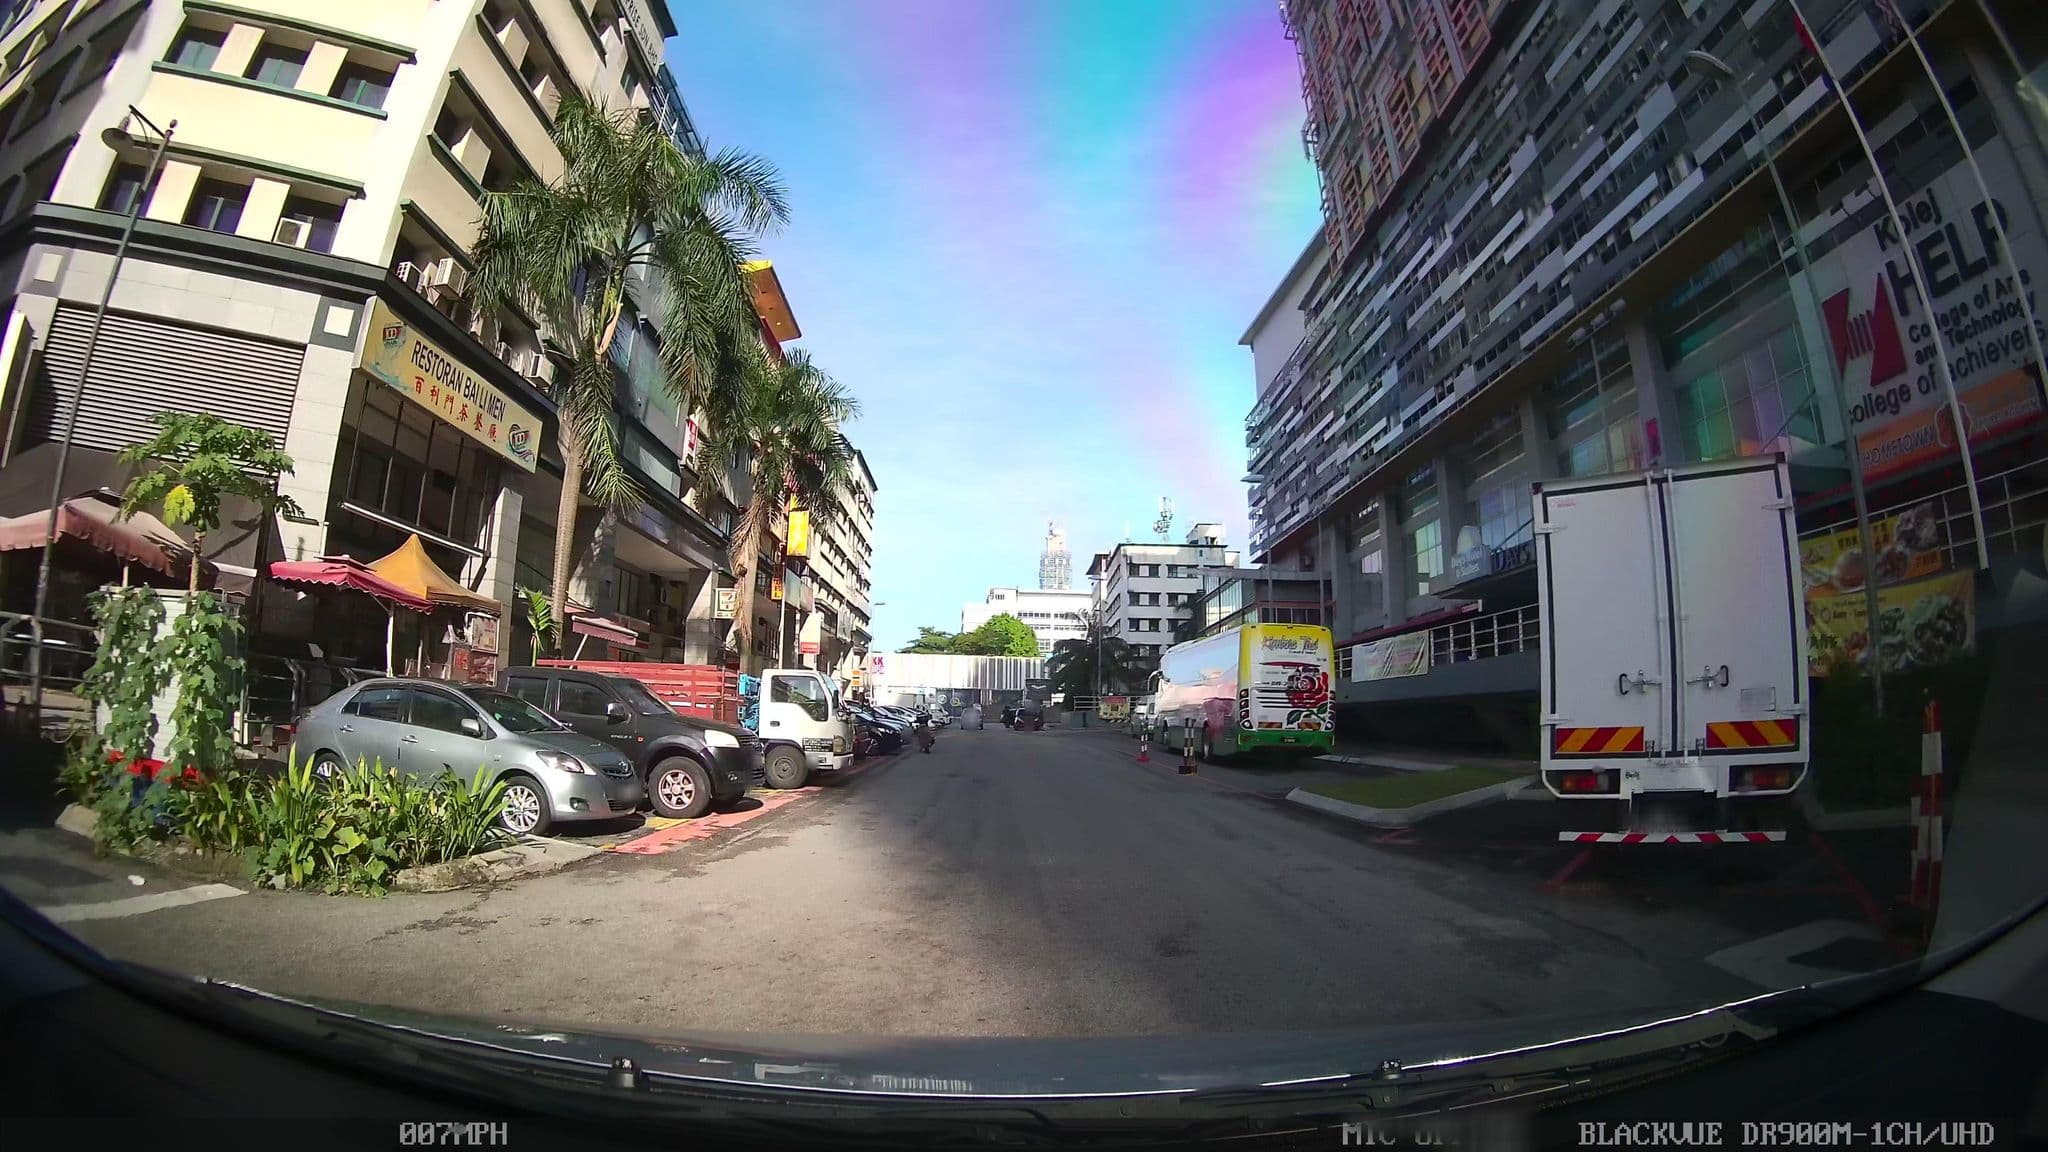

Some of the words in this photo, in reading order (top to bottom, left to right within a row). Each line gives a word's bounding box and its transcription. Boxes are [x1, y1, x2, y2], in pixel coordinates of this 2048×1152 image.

[1874, 187, 1942, 252] Kolej
[1885, 198, 2009, 316] HELP
[1909, 302, 1970, 343] Colege
[1973, 283, 1991, 309] of
[1995, 269, 2030, 300] Ars
[411, 340, 465, 394] RESTORAN
[463, 376, 481, 406] BAI
[487, 393, 506, 423] MEN
[1917, 363, 1937, 395] of
